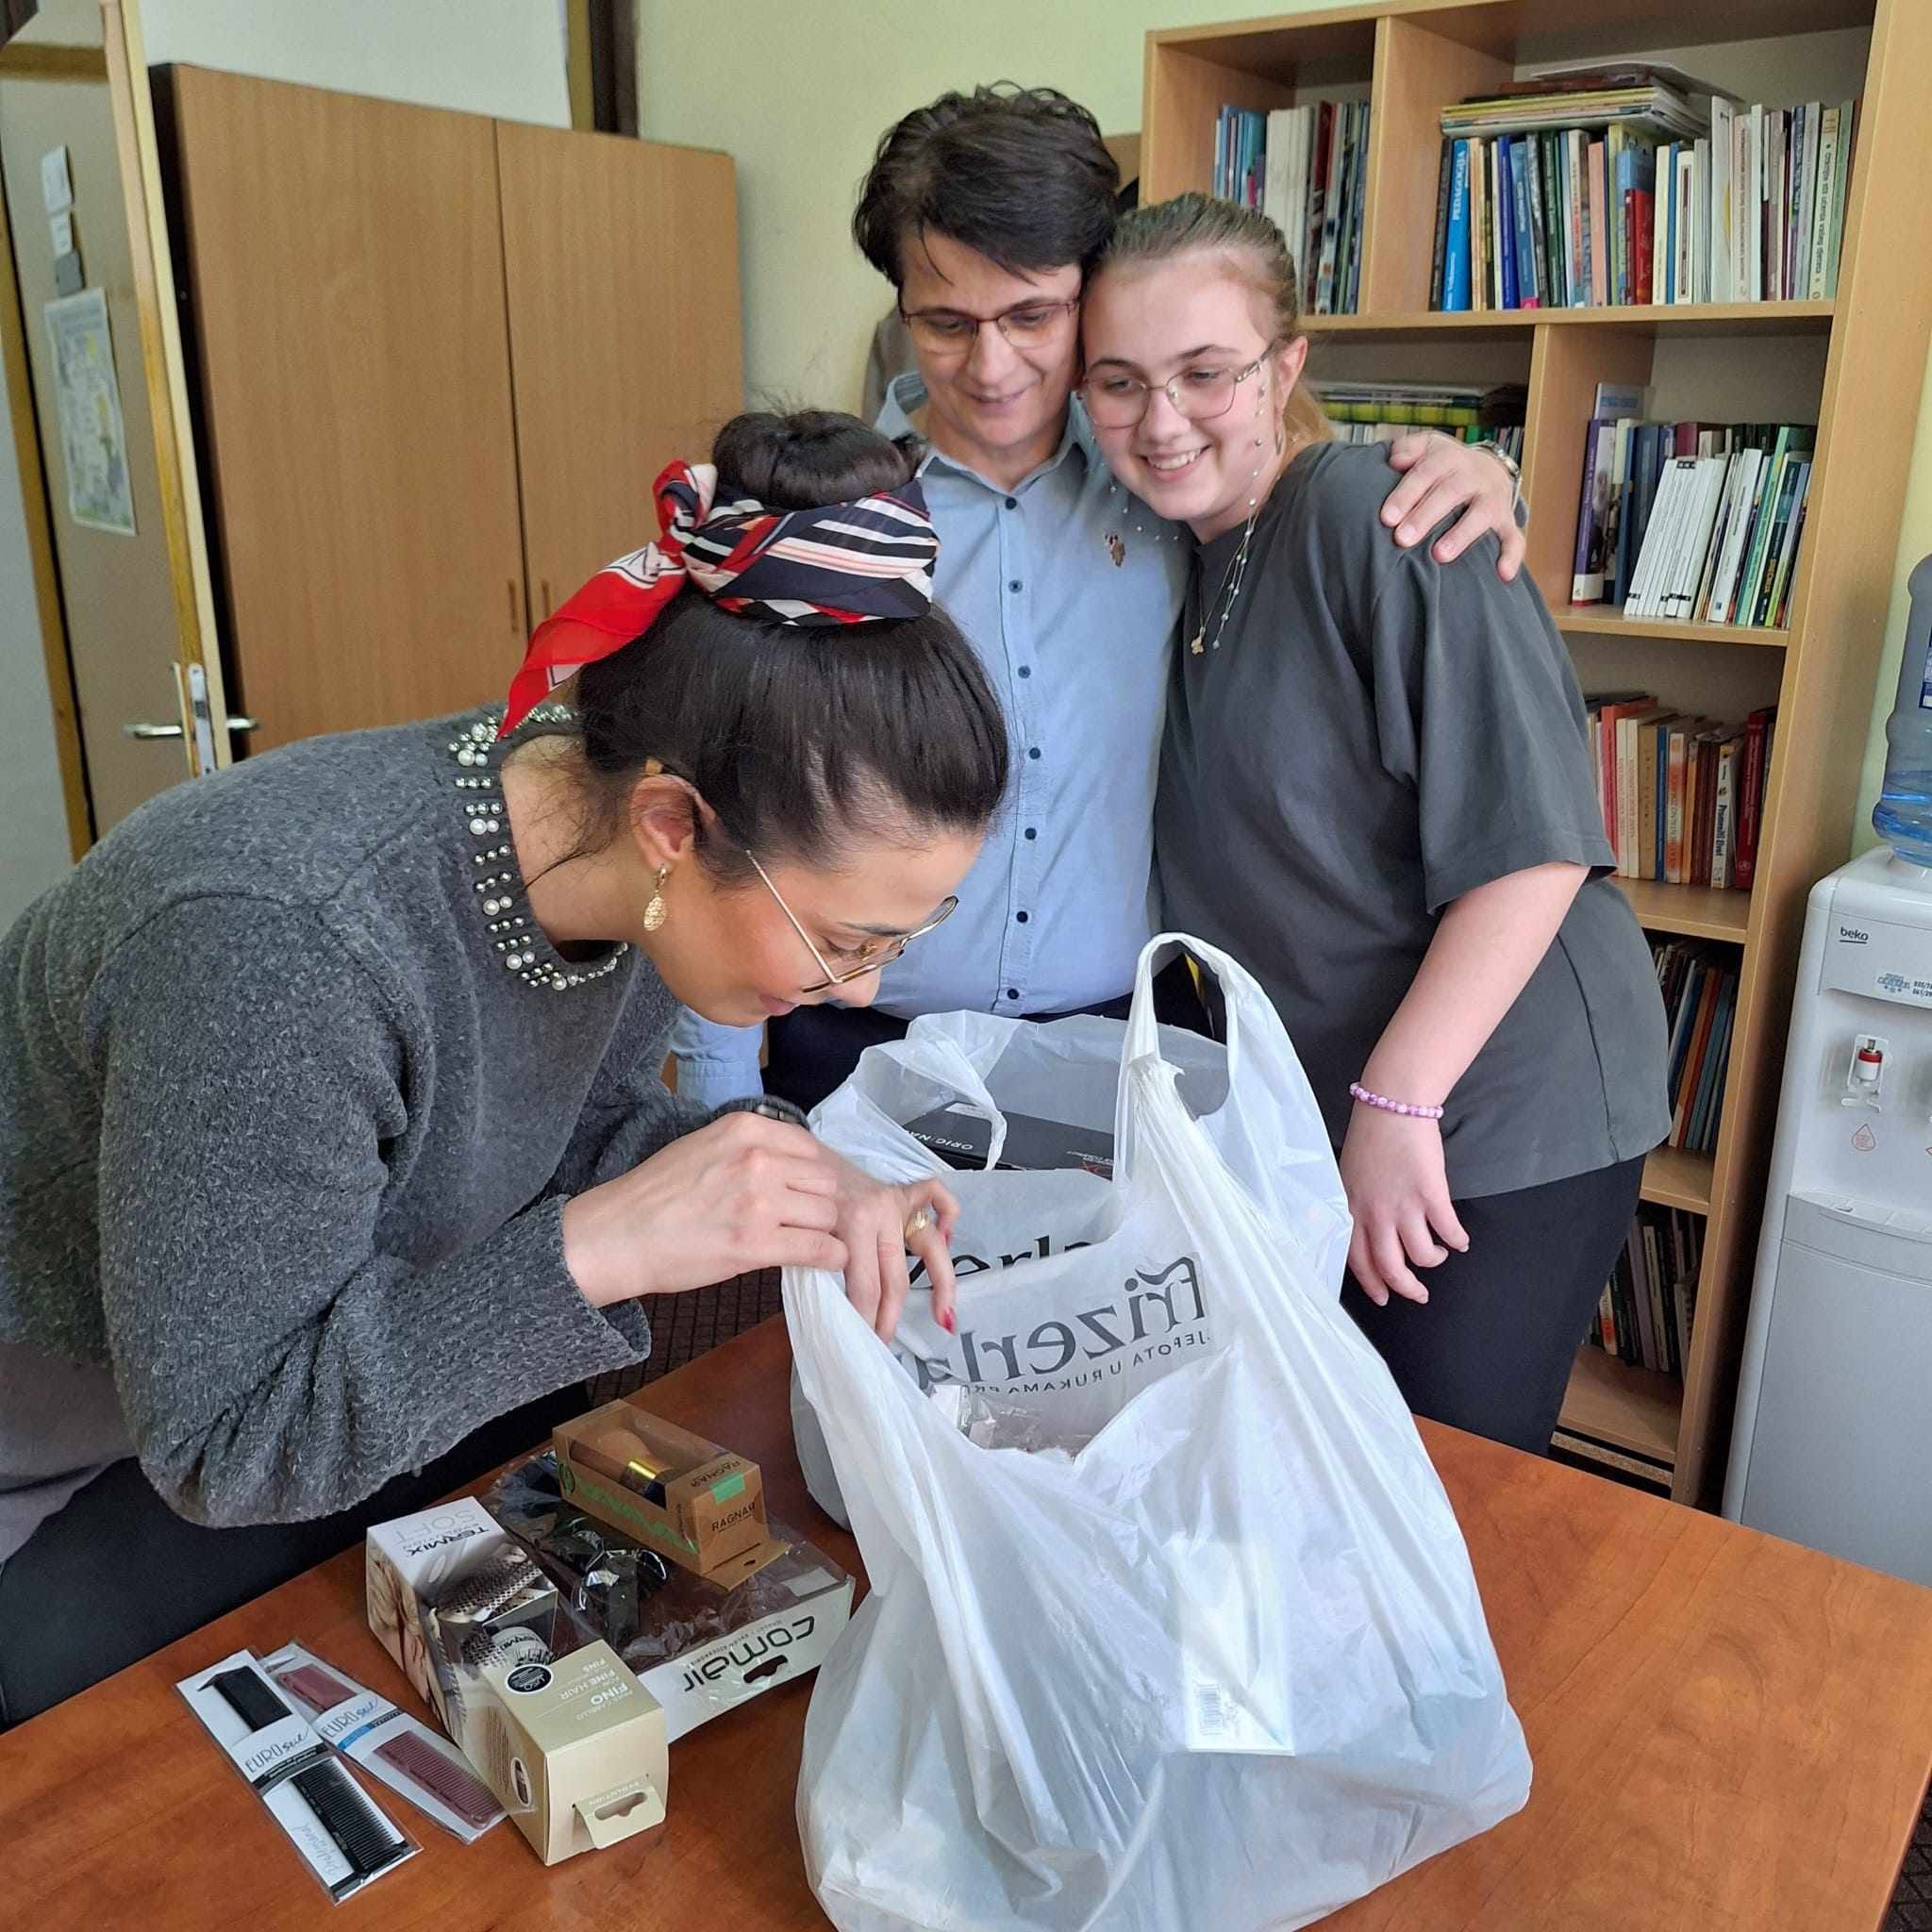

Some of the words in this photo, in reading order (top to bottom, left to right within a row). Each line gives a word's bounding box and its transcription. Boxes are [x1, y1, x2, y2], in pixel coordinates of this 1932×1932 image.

[1451, 149, 1467, 222] PEDAGOGIJA
[1840, 926, 1869, 941] beko
[391, 1508, 475, 1546] SOFT
[711, 1502, 756, 1532] RAGNAR
[406, 1527, 490, 1557] TERMIX
[683, 1615, 815, 1692] comair
[558, 1682, 587, 1701] HAIR
[588, 1669, 616, 1687] FINE
[591, 1682, 629, 1705] FINO
